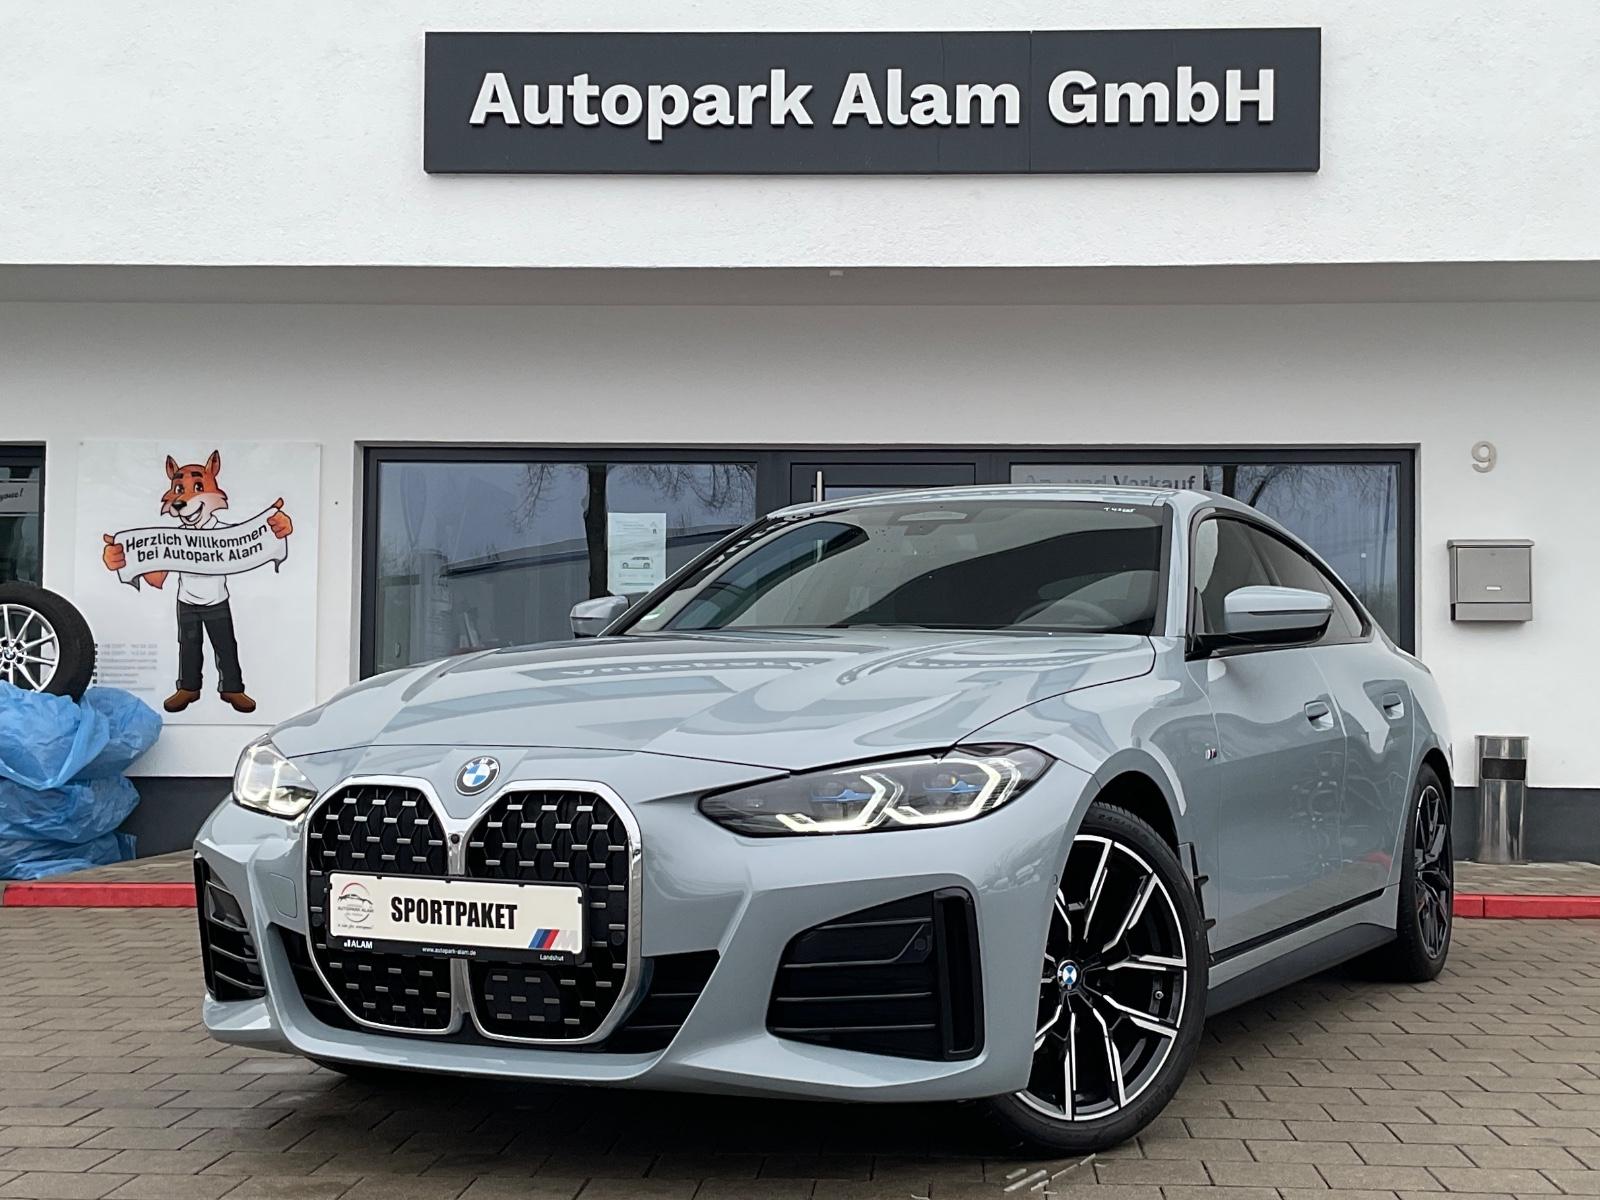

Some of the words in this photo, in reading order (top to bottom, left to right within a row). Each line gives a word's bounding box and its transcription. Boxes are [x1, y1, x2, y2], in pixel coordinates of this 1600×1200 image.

[469, 69, 814, 142] Autopark
[832, 69, 1022, 127] Alam
[1047, 66, 1277, 126] GmbH
[1471, 441, 1498, 474] 9
[126, 533, 182, 553] Herzlich
[184, 523, 268, 549] Willkommen
[137, 546, 159, 563] bei
[163, 546, 225, 563] Autopark
[228, 541, 263, 562] Alam
[391, 896, 518, 930] SPORTPAKET
[351, 939, 373, 949] ALAM
[422, 947, 477, 956] www.autopark-alam.de
[539, 953, 564, 962] Landshut
